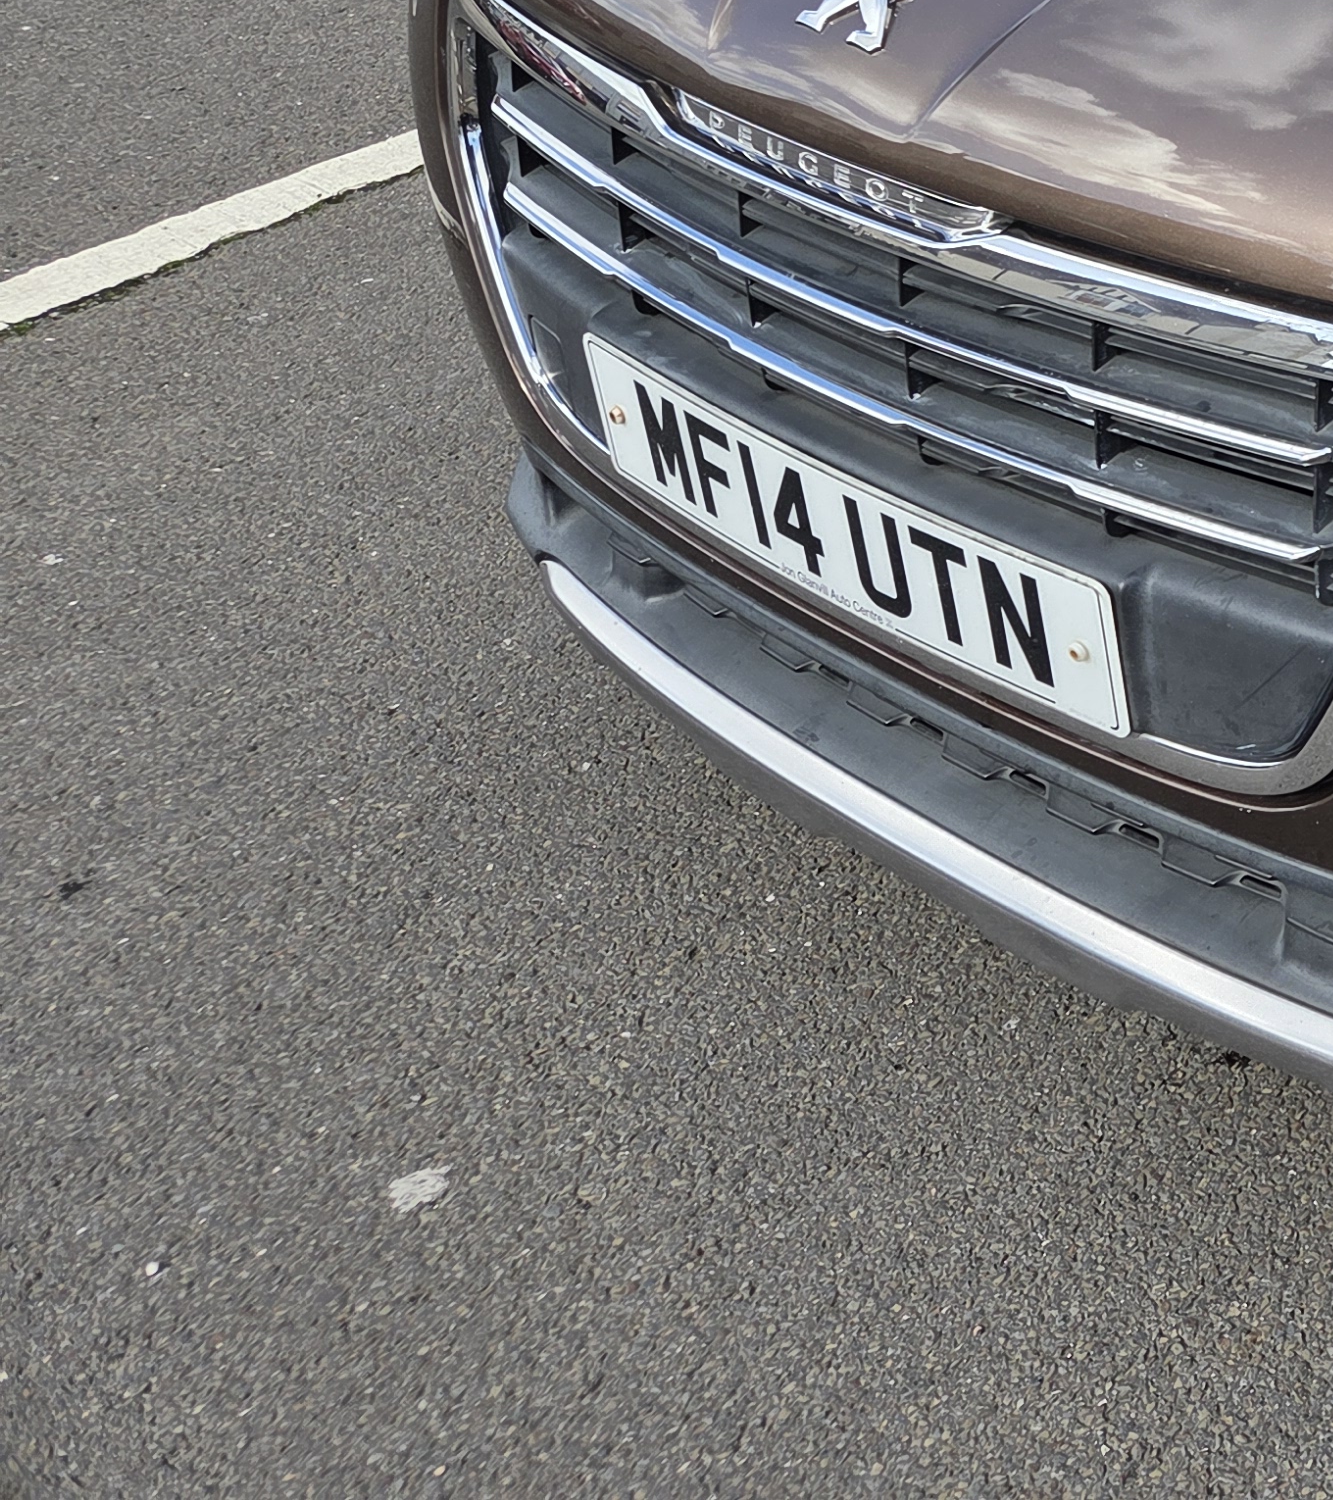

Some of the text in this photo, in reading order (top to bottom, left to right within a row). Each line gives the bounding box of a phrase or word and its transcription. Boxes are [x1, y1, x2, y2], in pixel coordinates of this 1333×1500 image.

[708, 110, 924, 213] PEUGEOT
[634, 380, 1056, 688] MF14 UTN
[831, 589, 851, 608] Auto
